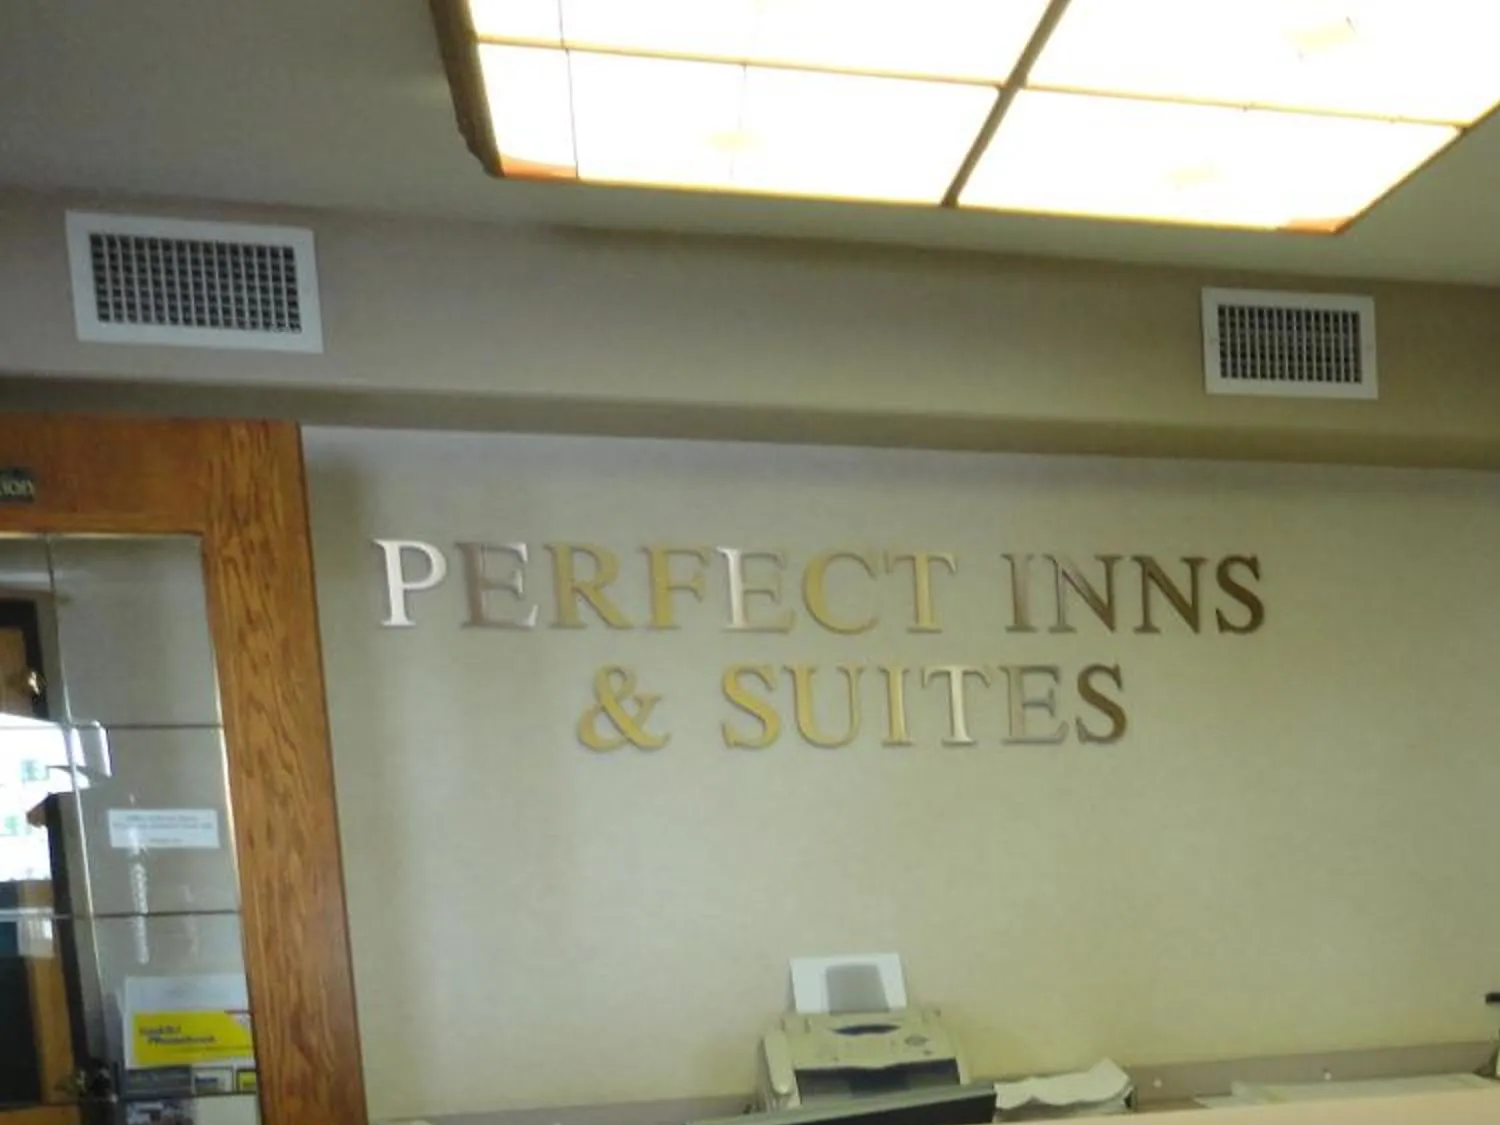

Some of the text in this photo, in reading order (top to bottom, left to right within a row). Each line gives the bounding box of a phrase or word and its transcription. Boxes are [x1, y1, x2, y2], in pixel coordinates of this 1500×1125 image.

[374, 538, 1266, 635] PERFECT INNS
[577, 662, 1127, 750] & SUITES
